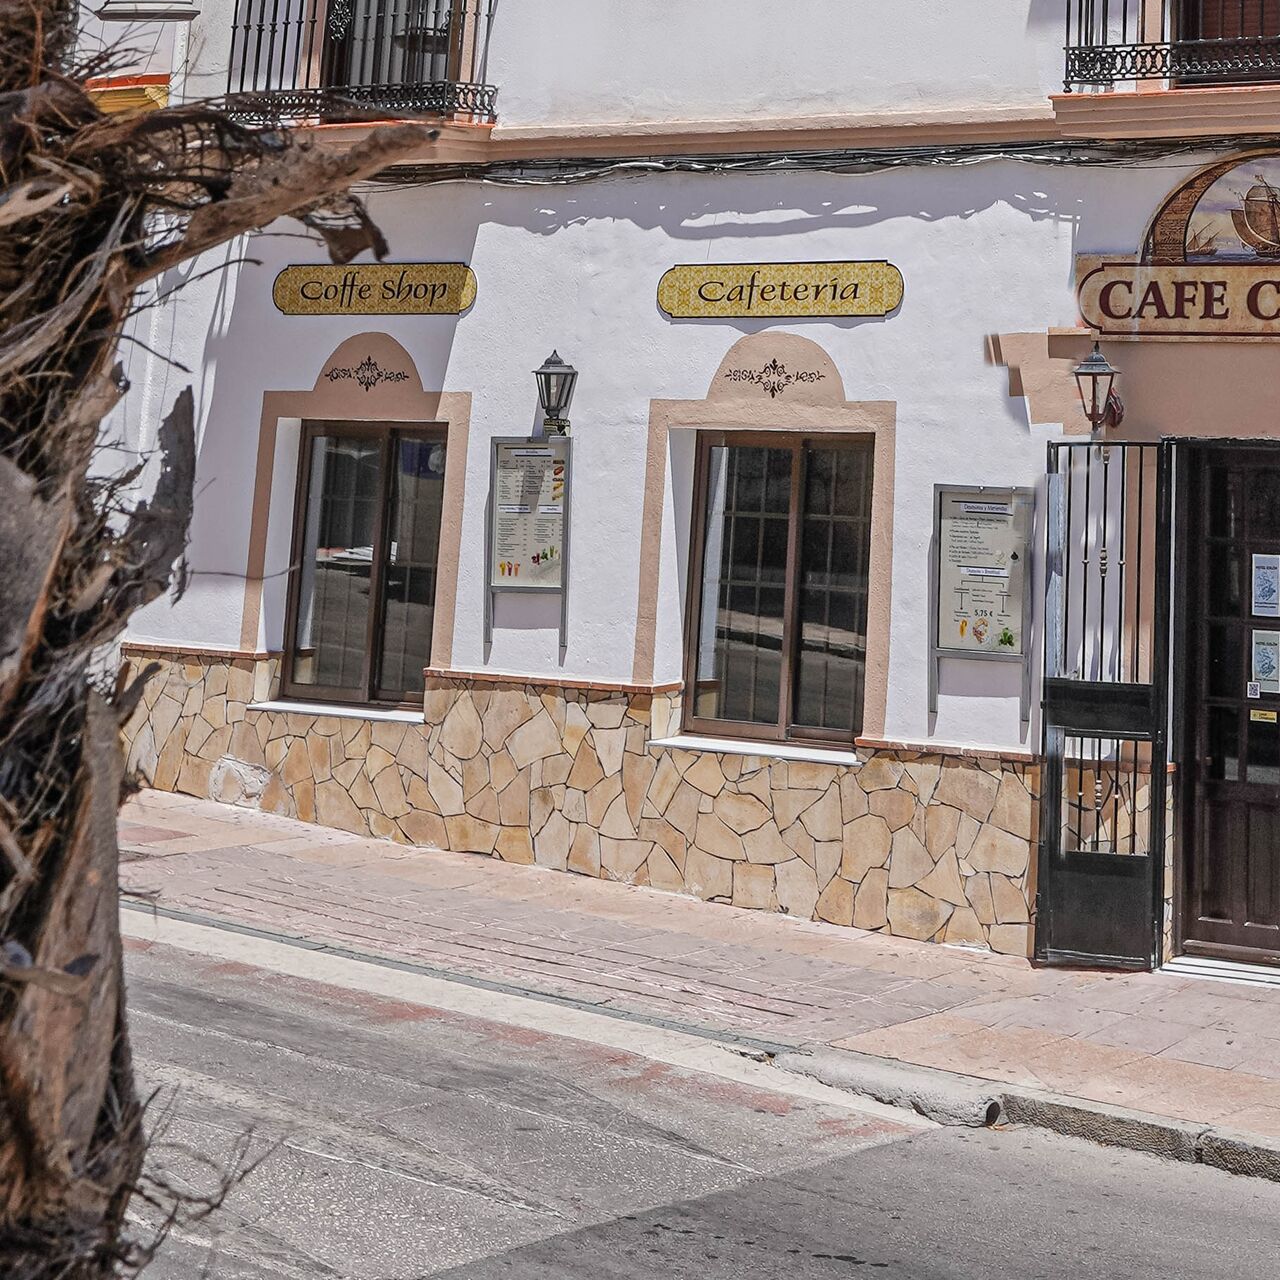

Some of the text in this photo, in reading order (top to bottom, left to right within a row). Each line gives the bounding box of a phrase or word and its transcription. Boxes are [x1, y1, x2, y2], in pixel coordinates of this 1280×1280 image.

[301, 270, 448, 307] Coffe Shop
[698, 270, 861, 310] Cafetería
[1099, 279, 1230, 320] CAFE
